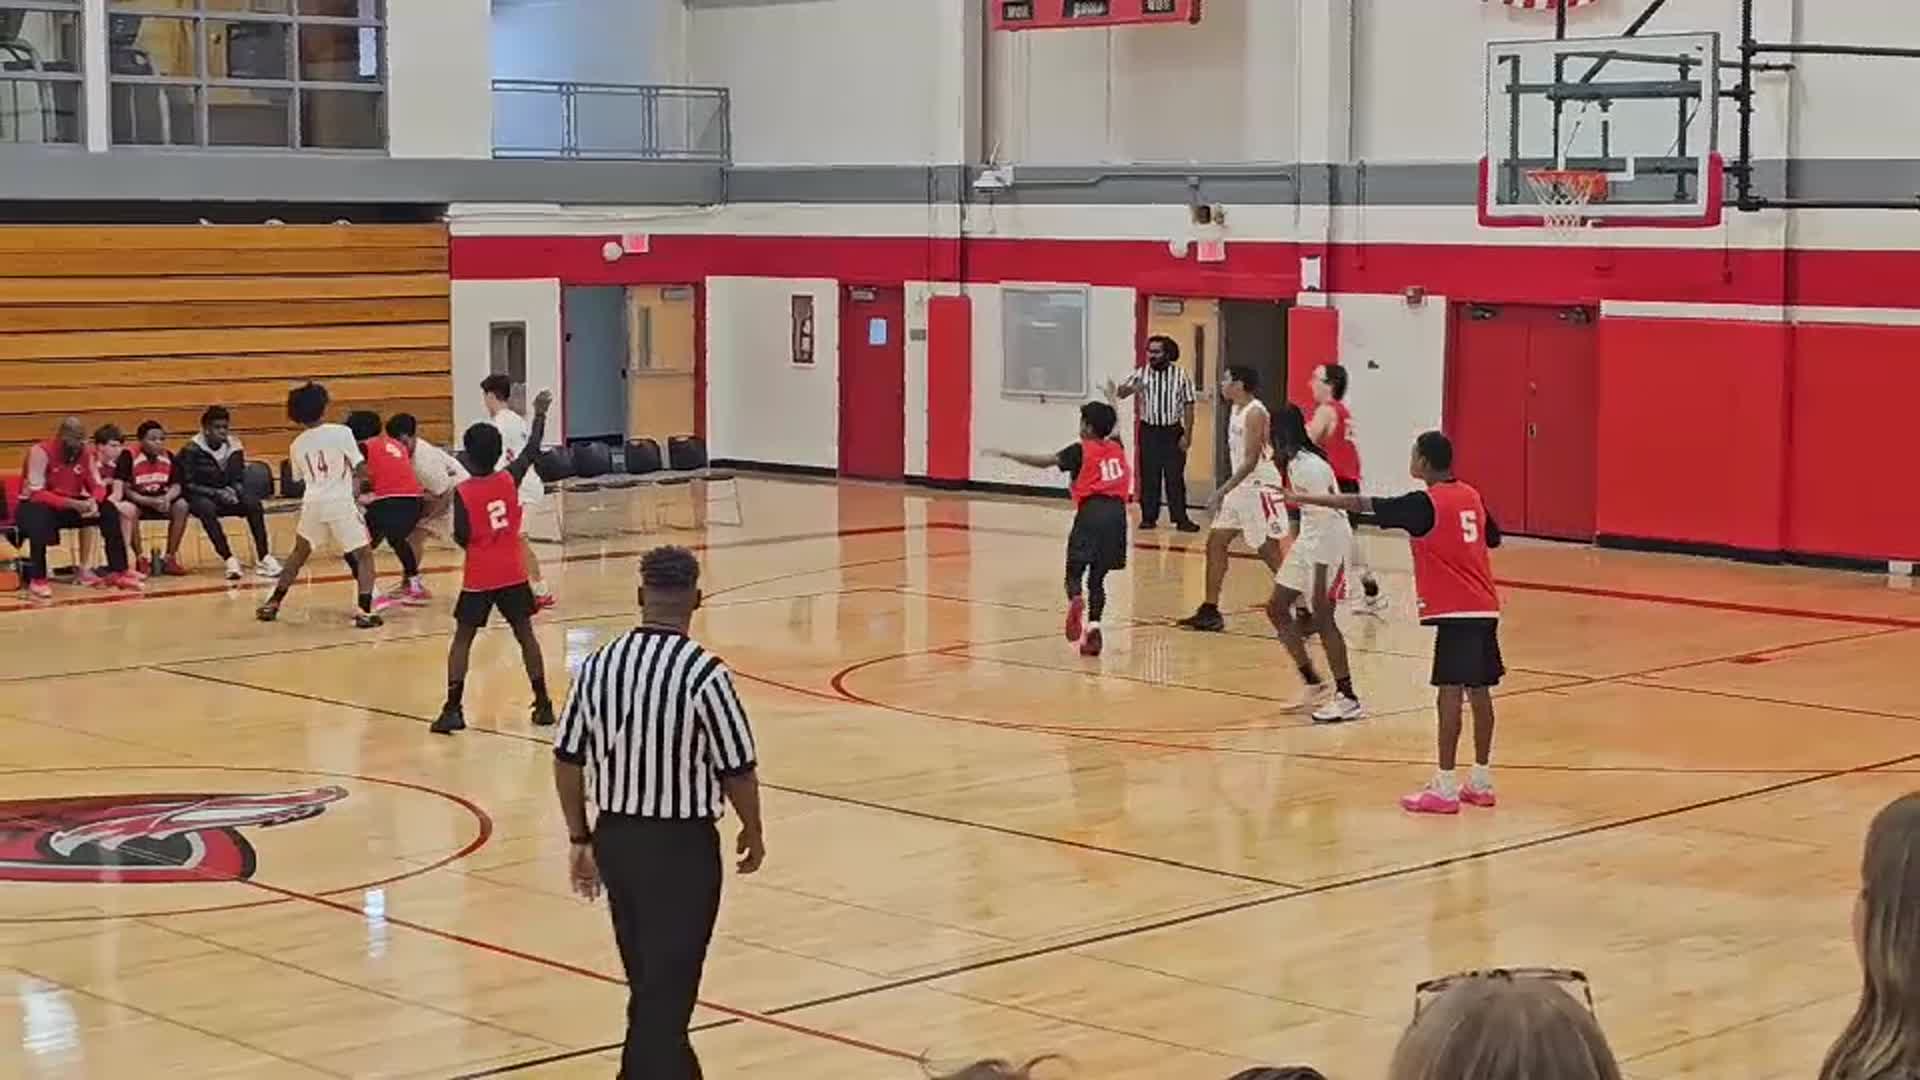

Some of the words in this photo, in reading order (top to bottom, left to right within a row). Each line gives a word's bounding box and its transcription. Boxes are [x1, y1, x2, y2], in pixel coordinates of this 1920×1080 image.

[304, 450, 329, 479] 14
[1099, 458, 1124, 481] 10
[487, 499, 509, 530] 2
[1459, 509, 1479, 543] 5
